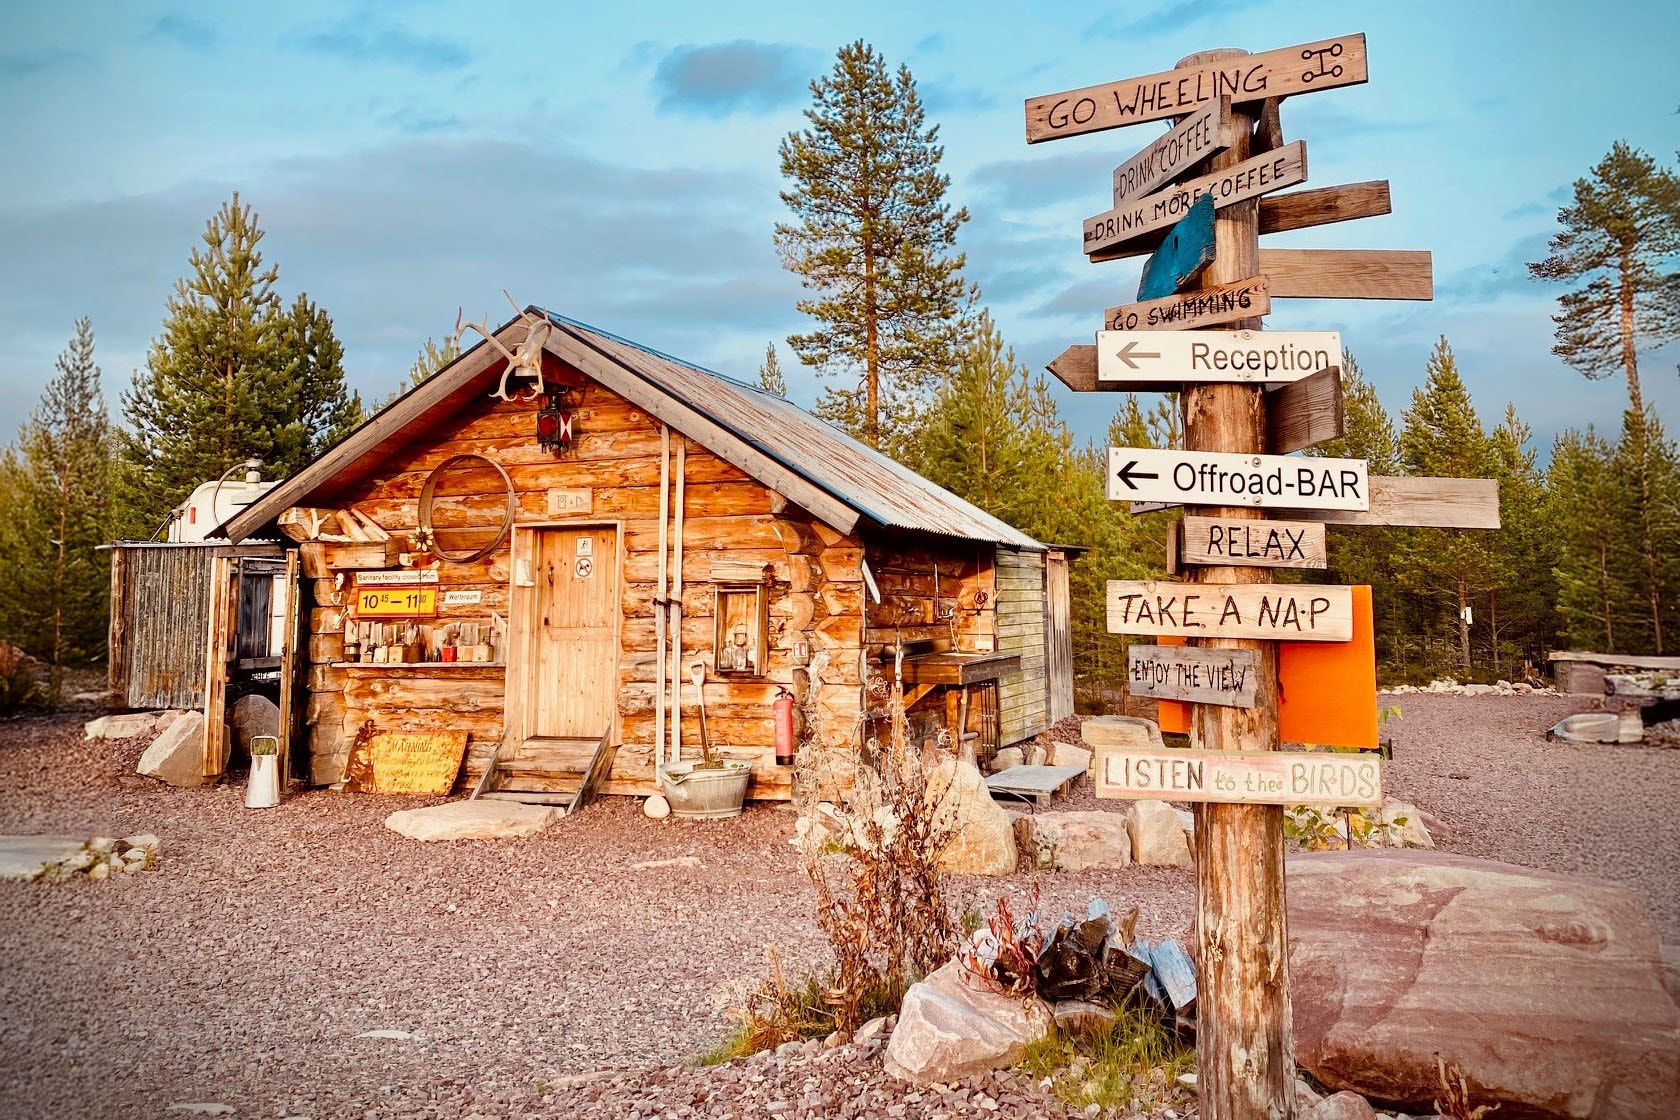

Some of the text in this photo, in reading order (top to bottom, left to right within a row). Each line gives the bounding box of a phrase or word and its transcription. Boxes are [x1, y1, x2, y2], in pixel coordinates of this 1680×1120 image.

[1048, 63, 1268, 130] GO WHEELING
[1119, 113, 1212, 200] DRINK COFFEE
[1094, 209, 1144, 242] DRINK
[1210, 157, 1286, 202] COFFEE
[1112, 288, 1252, 331] GO SWIMMING
[1192, 342, 1329, 377] Reception
[1173, 462, 1361, 499] Offroad-BAR
[1206, 525, 1305, 560] RELAX
[358, 574, 381, 582] Sanitary
[382, 573, 401, 582] facility
[362, 594, 379, 609] 10
[1118, 594, 1331, 631] TAKE A NAP
[1134, 659, 1246, 692] ENJOY THE VIEW
[1104, 757, 1376, 798] LISTEN to the BIRDS
